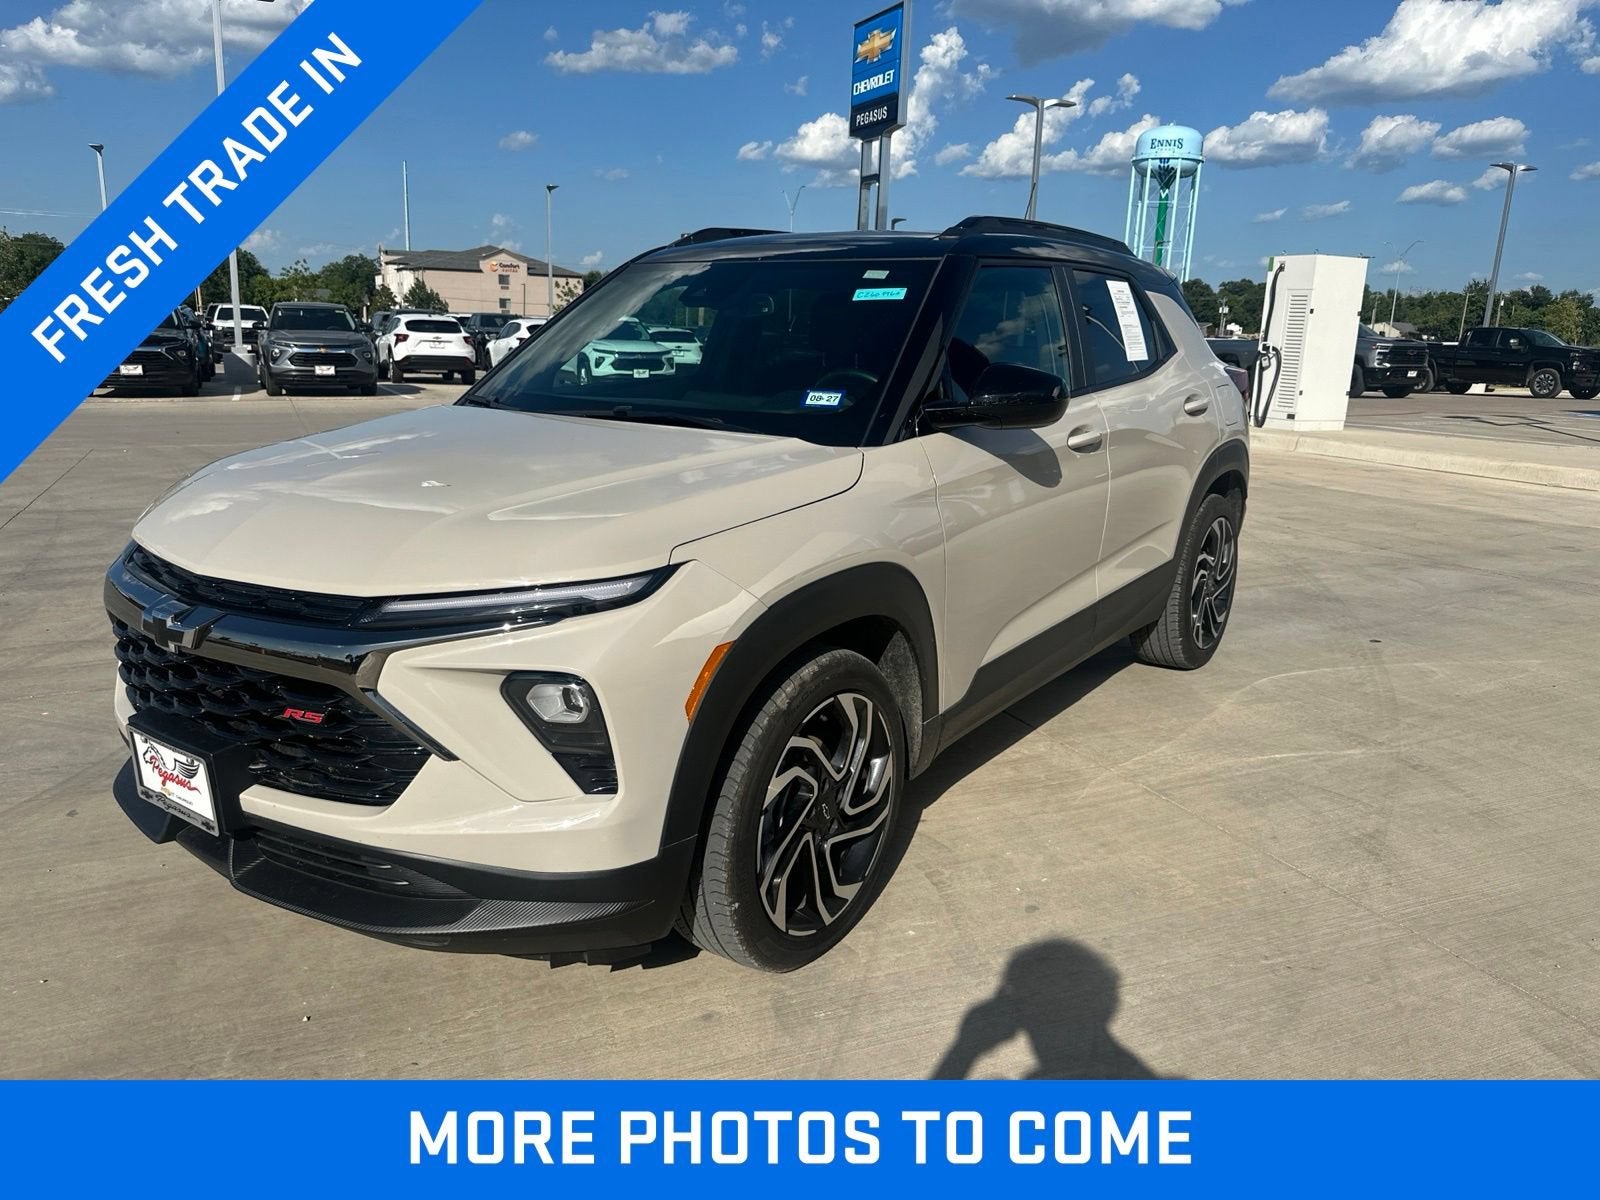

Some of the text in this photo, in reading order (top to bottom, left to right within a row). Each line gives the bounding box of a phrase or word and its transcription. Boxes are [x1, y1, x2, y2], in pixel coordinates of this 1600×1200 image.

[853, 69, 894, 95] CHEVROLET
[856, 106, 887, 126] PEGASUS
[1150, 138, 1184, 149] ENNIS
[283, 708, 325, 724] RS
[148, 754, 202, 795] Pegasus
